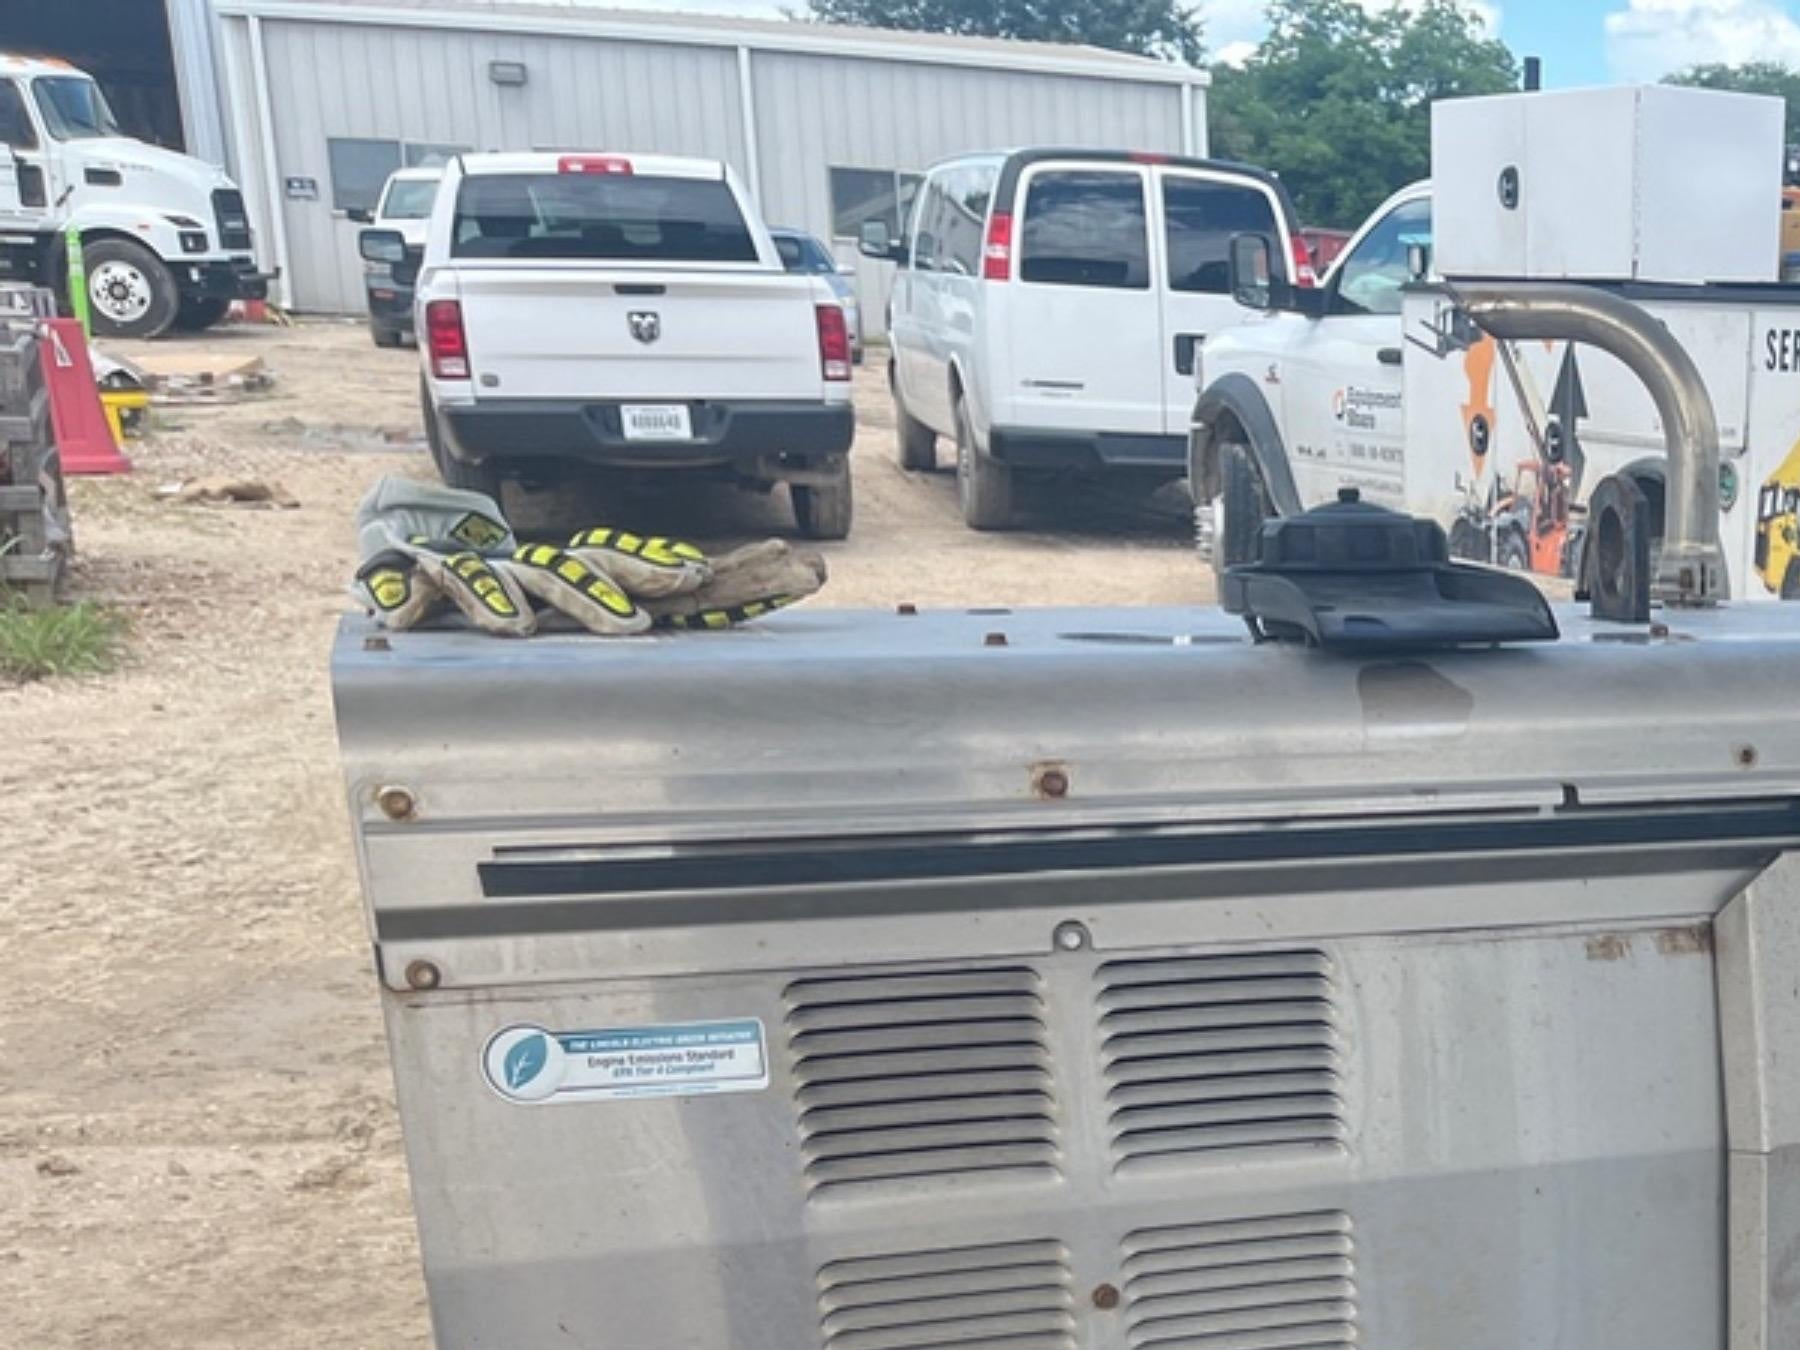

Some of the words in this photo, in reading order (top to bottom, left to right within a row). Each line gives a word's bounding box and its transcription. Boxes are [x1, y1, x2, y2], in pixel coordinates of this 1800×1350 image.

[587, 1055, 625, 1070] Engine
[628, 1052, 684, 1066] Emissions
[686, 1048, 736, 1062] Standard
